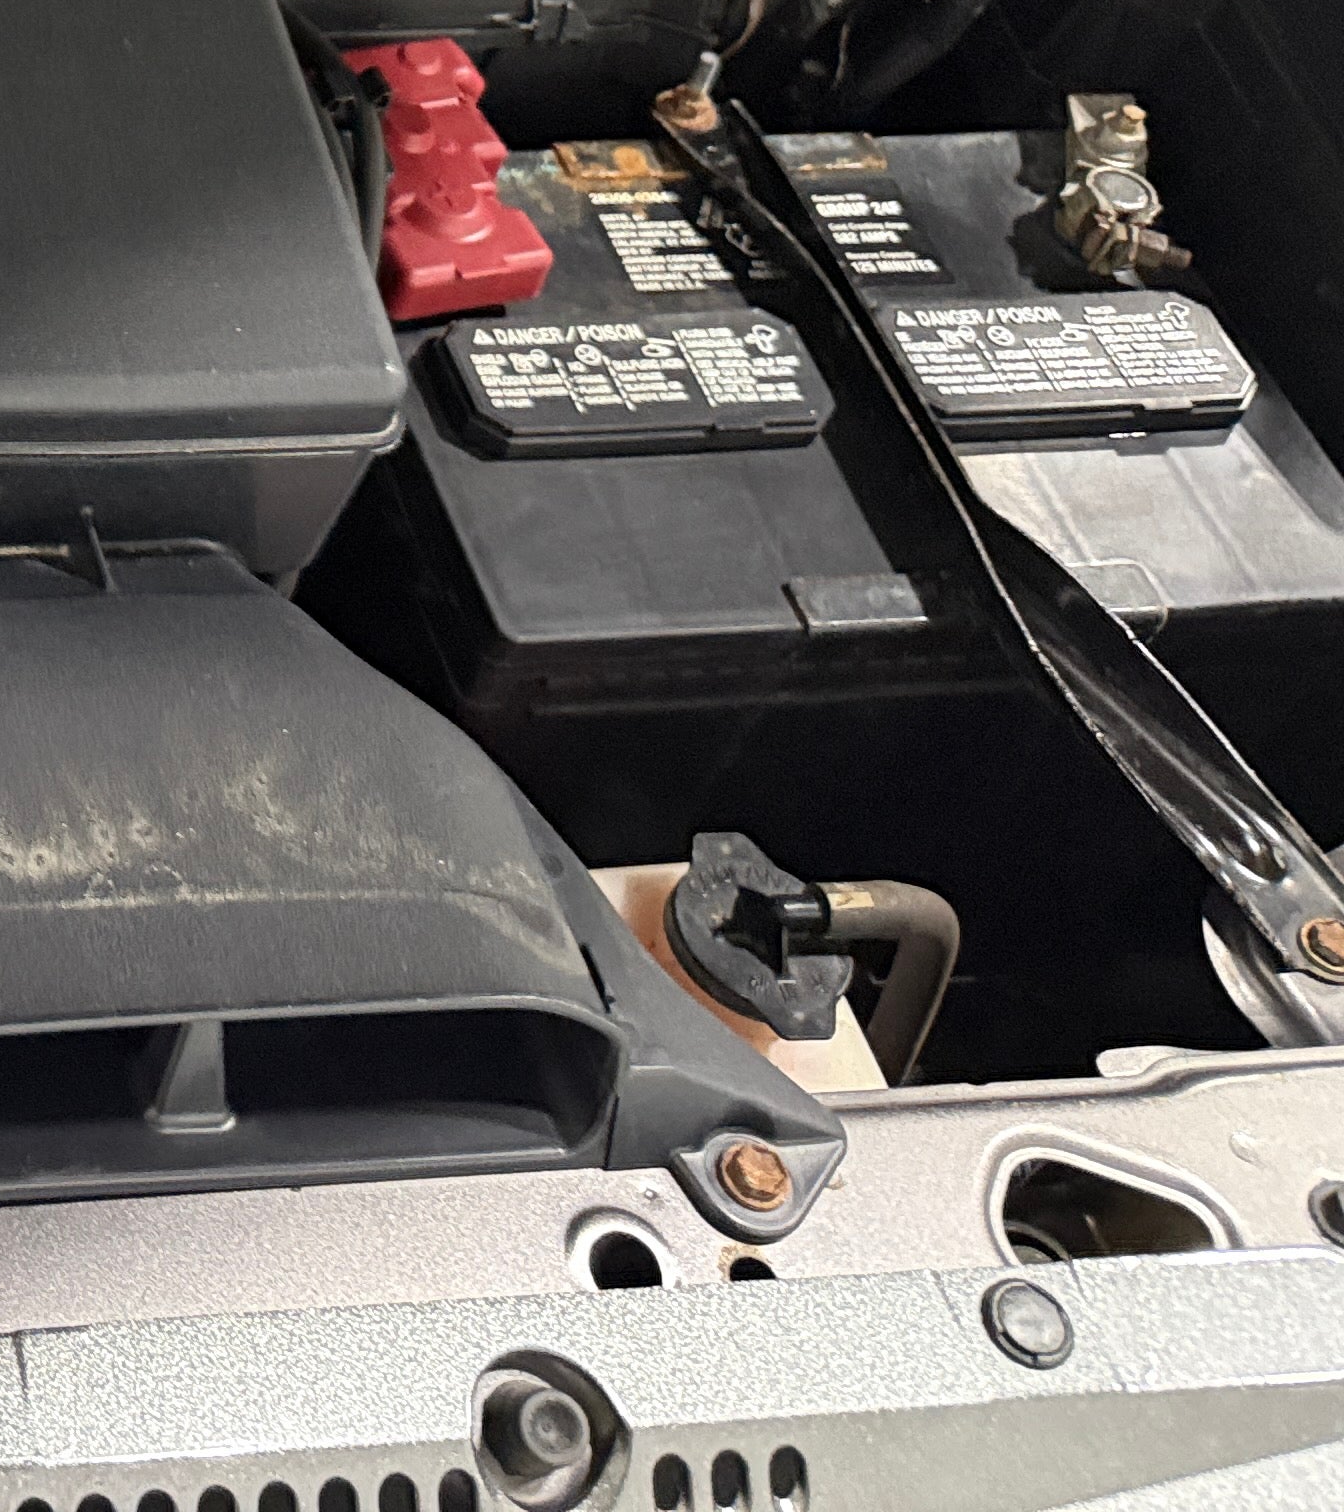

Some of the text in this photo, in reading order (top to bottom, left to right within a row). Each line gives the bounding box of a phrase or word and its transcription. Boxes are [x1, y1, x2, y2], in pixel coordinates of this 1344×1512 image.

[850, 259, 940, 273] 125 MINUTES
[914, 309, 985, 327] DANGER
[996, 306, 1062, 324] POISON
[492, 327, 565, 345] DANGER
[577, 323, 646, 342] POISON
